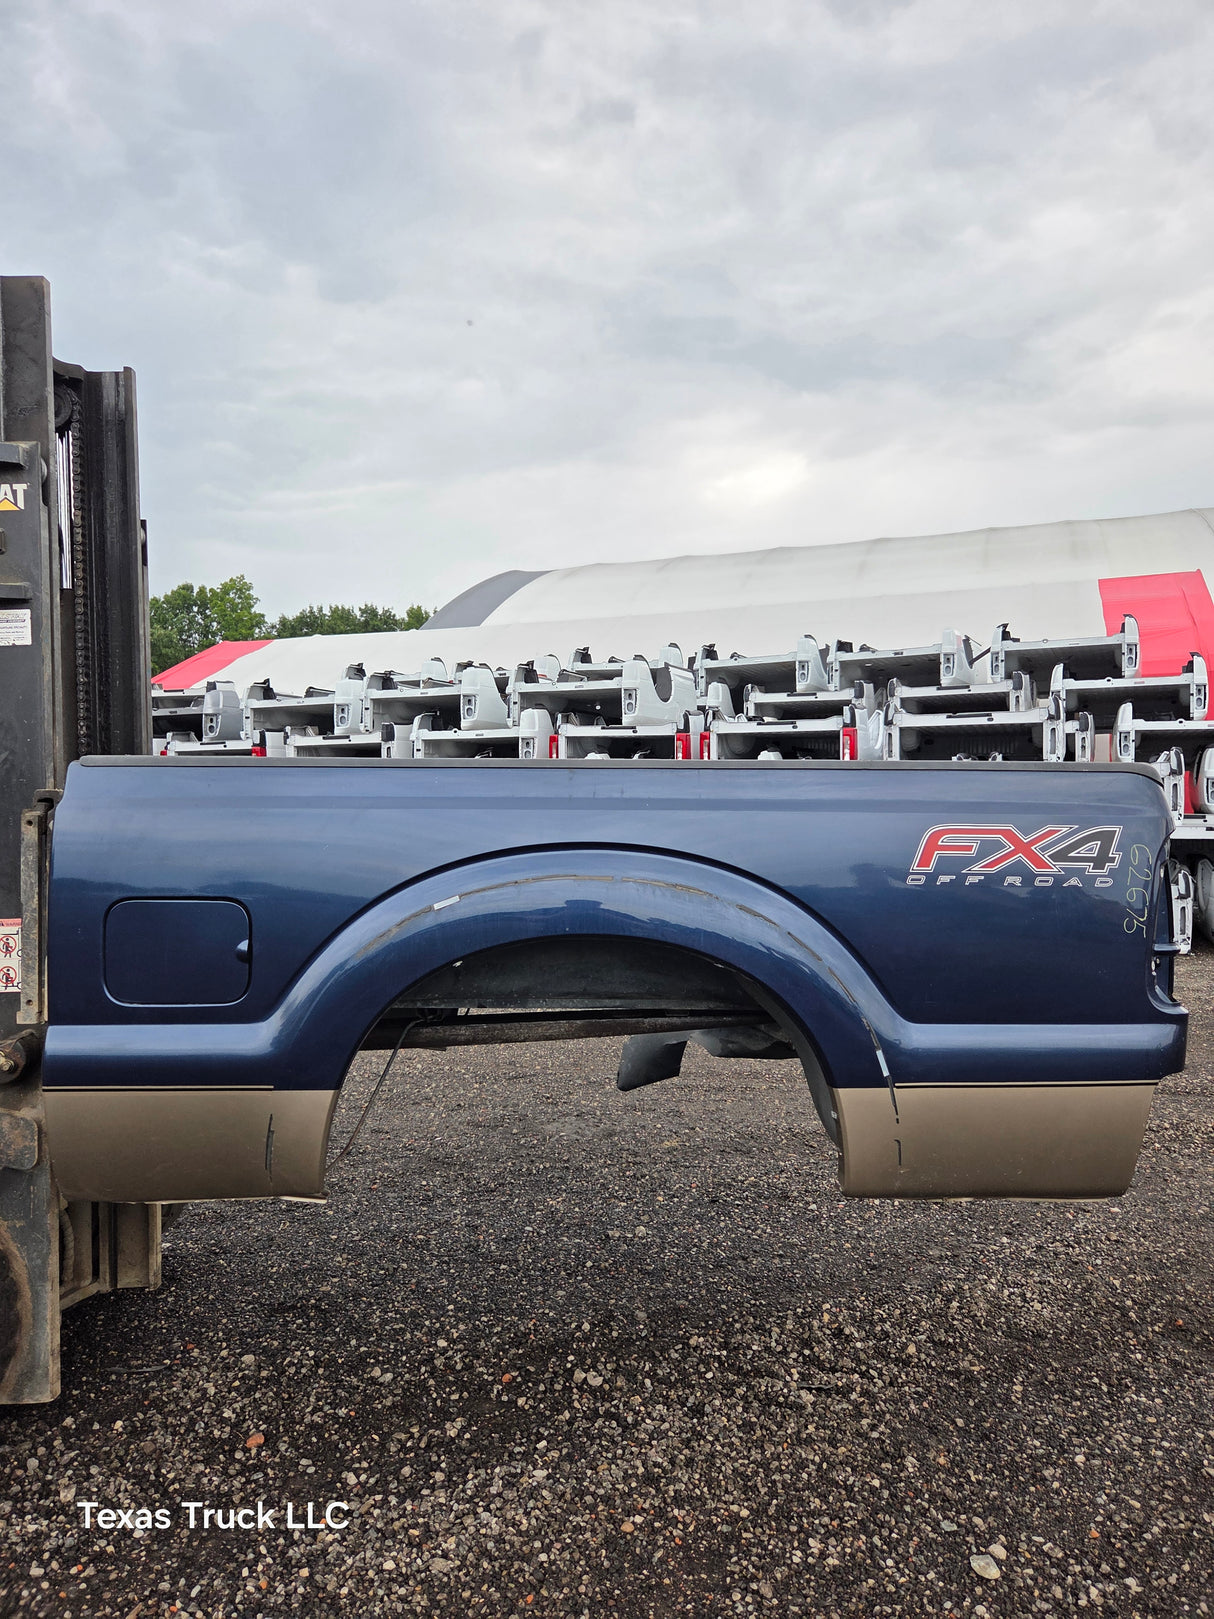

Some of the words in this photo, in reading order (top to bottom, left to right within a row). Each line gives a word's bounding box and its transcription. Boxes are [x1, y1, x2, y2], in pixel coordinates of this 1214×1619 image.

[909, 823, 1124, 875] FX4
[906, 874, 985, 886] OFF
[1003, 875, 1114, 888] ROAD
[1123, 843, 1152, 938] 62675
